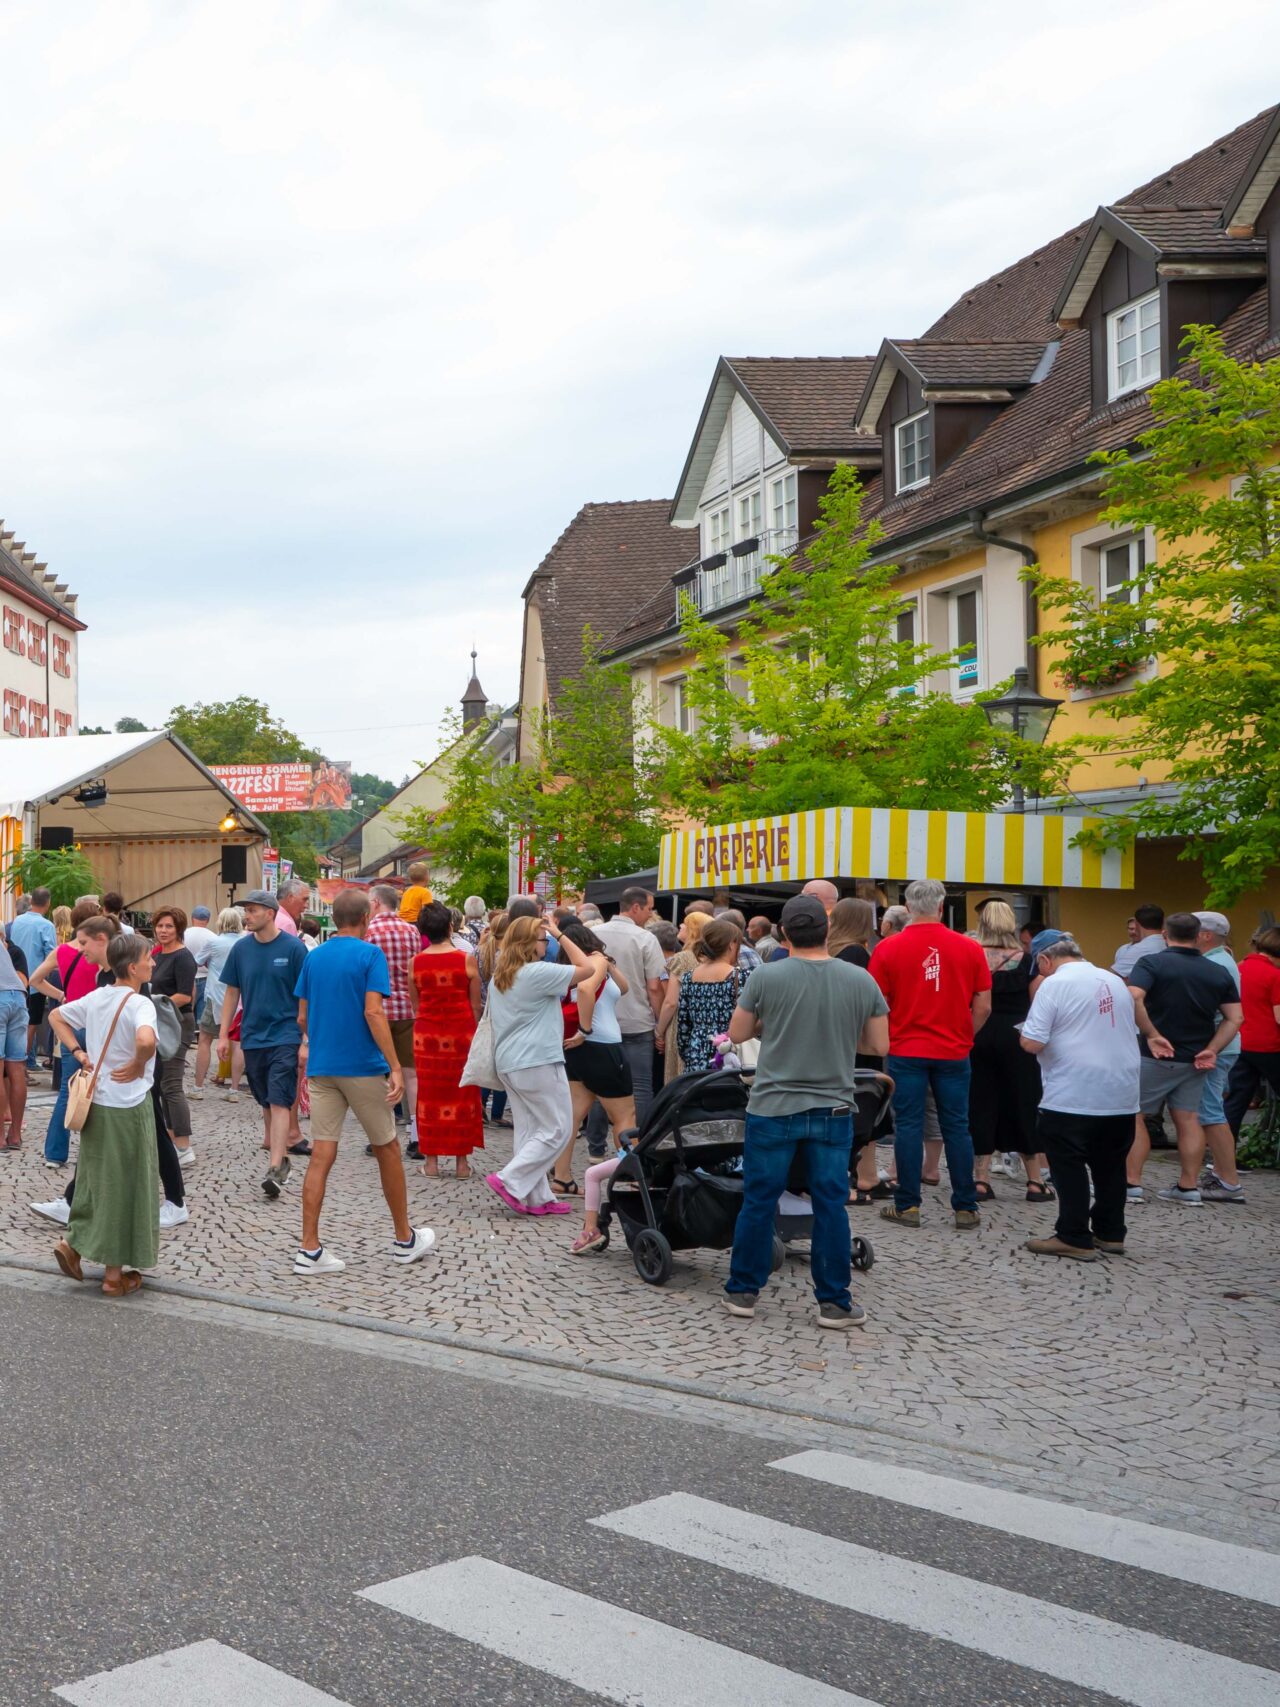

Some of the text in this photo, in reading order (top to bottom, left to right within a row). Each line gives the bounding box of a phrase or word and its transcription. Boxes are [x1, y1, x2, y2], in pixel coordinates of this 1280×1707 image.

[964, 663, 977, 673] CDU
[266, 764, 311, 774] SOMMER
[245, 797, 284, 805] Samstag
[262, 803, 279, 811] Juli
[695, 826, 789, 876] CREPERIE
[1099, 996, 1113, 1007] JAZZ
